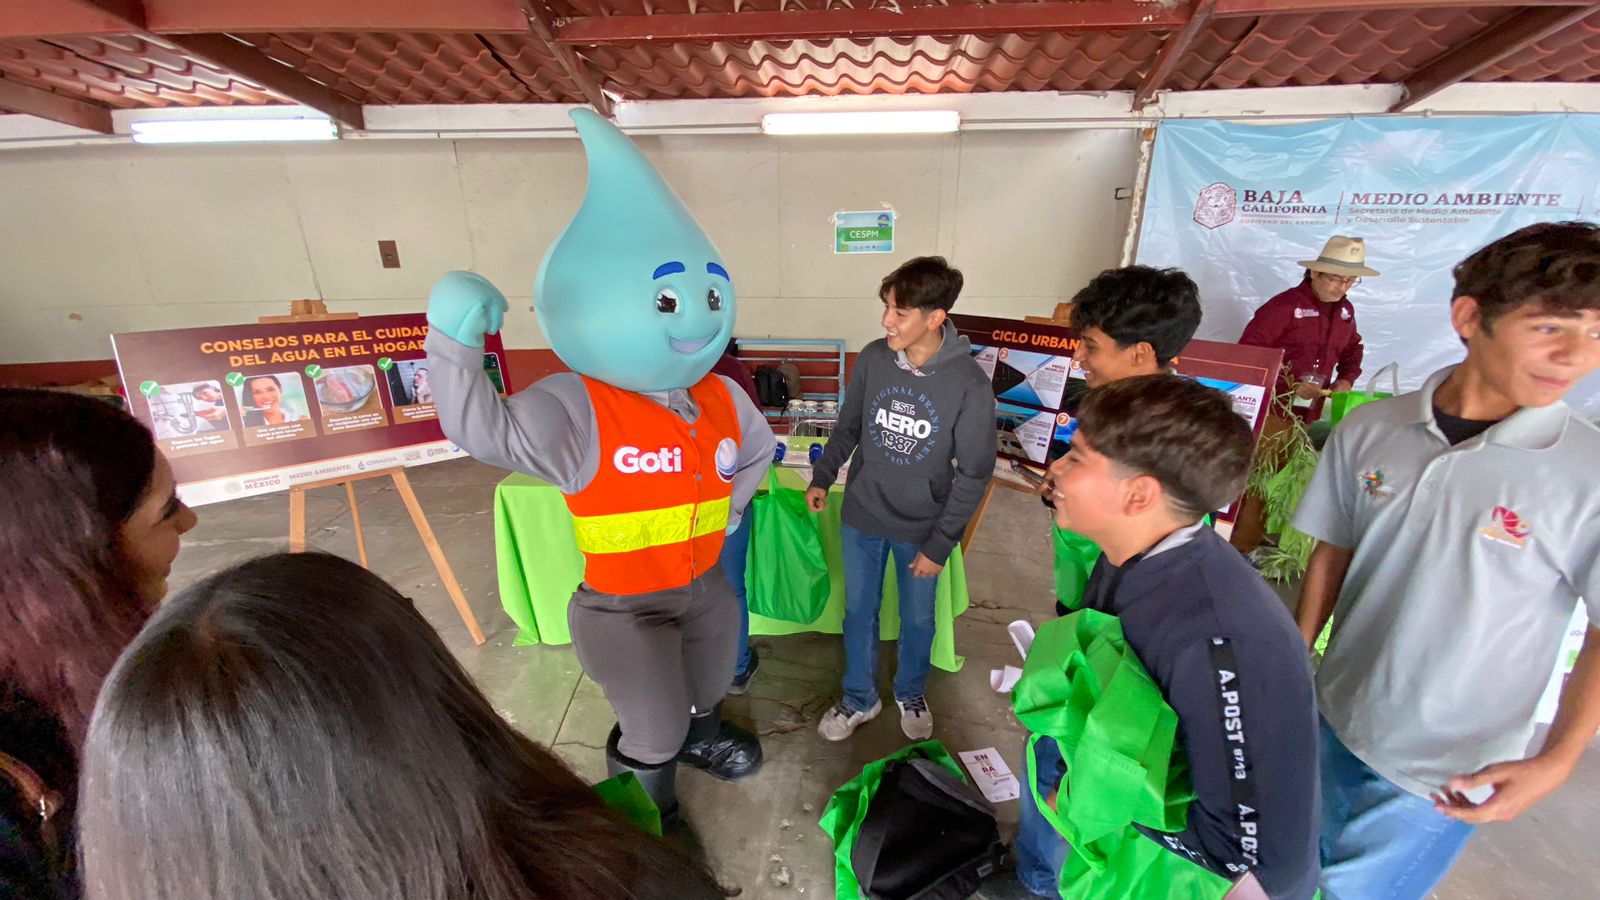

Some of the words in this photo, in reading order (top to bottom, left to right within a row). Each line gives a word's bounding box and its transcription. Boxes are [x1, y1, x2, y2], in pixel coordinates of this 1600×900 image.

[1243, 189, 1304, 205] BAJA
[1350, 193, 1428, 206] MEDIO
[1433, 193, 1561, 207] AMBIENTE
[1241, 204, 1327, 214] CALIFORNIA
[1450, 208, 1501, 216] Ambiente
[849, 230, 879, 239] CESPM
[200, 335, 299, 354] CONSEJOS
[303, 329, 349, 346] PARA
[352, 329, 373, 342] EL
[992, 330, 1028, 344] CICLO
[229, 354, 267, 368] DEL
[271, 348, 320, 364] AGUA
[323, 345, 347, 359] EN
[350, 343, 371, 356] EL
[891, 399, 915, 415] EST.
[918, 394, 939, 433] BRAND
[875, 408, 932, 439] AERO
[881, 430, 917, 455] 1987
[613, 446, 682, 474] Goti
[289, 470, 313, 480] MEDIO
[244, 478, 281, 490] MÉXICO
[1218, 669, 1245, 743] A.POST
